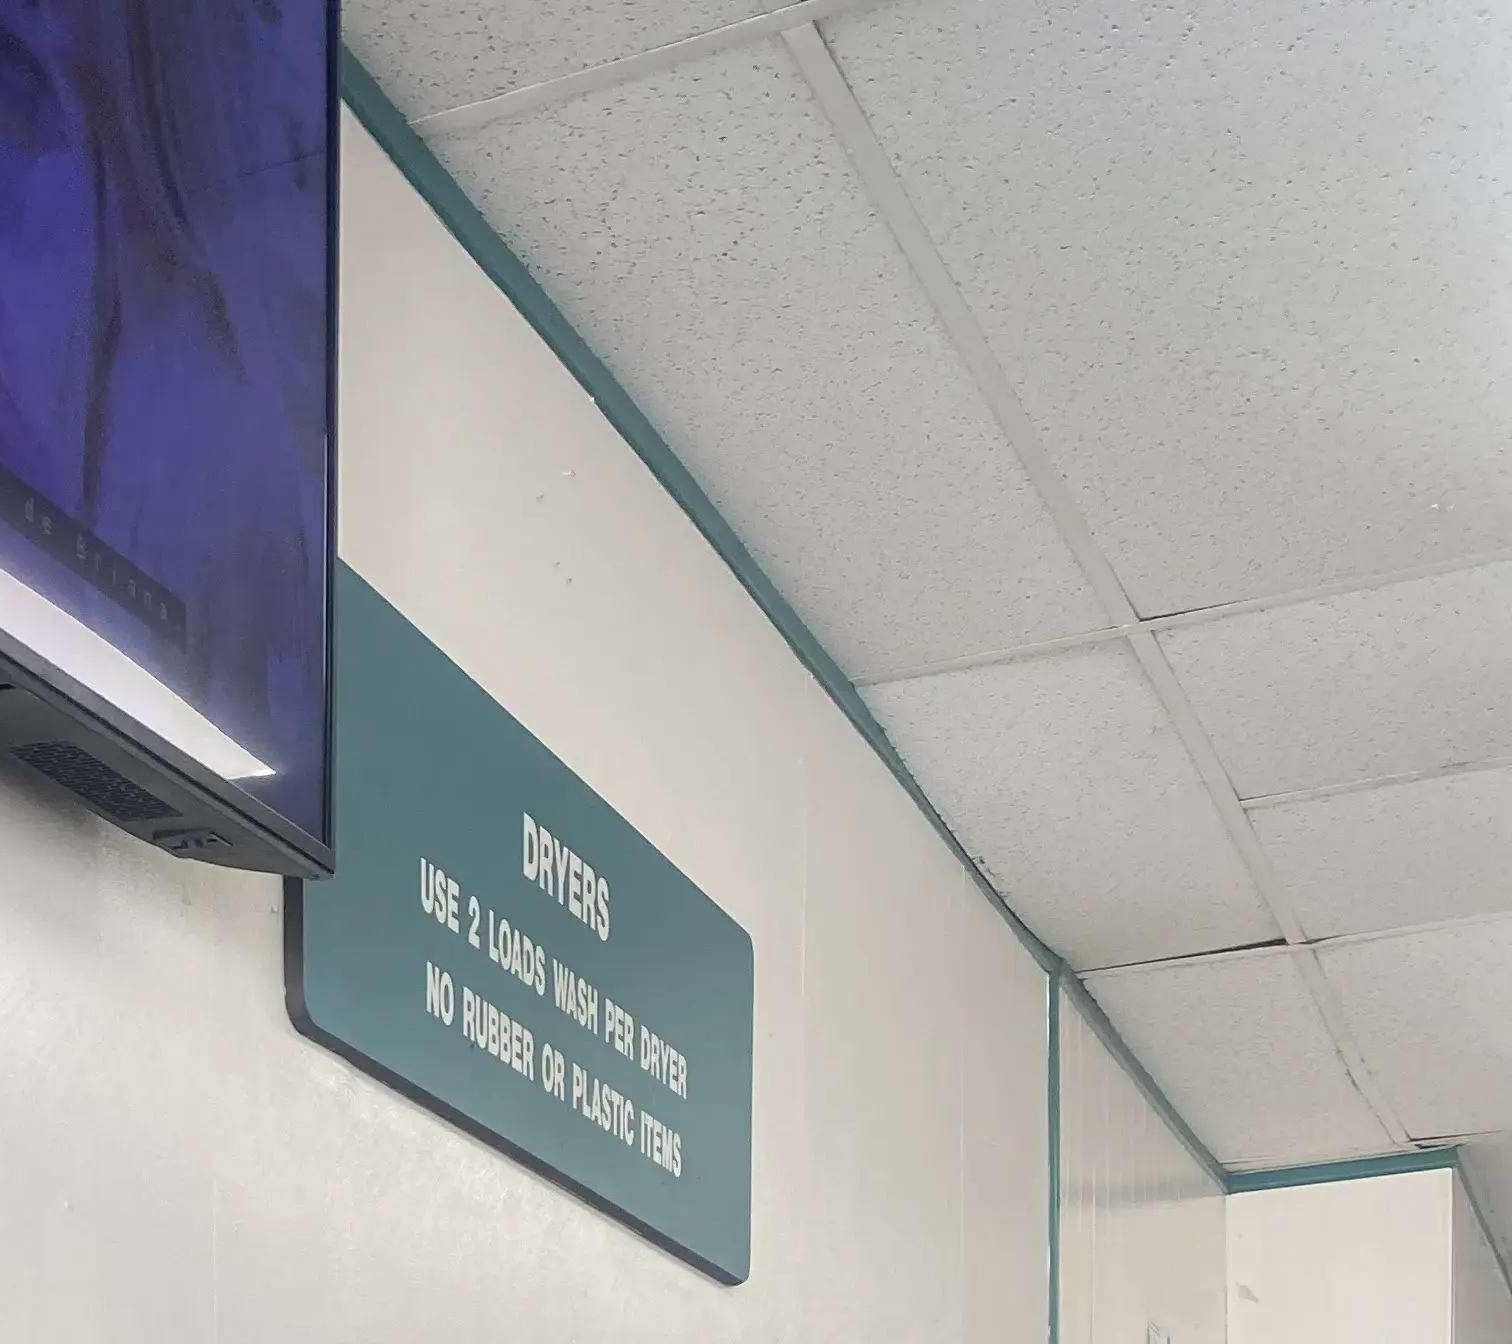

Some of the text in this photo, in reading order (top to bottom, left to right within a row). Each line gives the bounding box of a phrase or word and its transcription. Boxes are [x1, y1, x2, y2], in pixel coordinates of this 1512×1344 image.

[24, 497, 52, 536] de
[523, 811, 610, 941] DRYERS
[420, 857, 687, 1100] USE 2 LOADS WASH PER DRYER
[426, 960, 682, 1178] NO RUBBER OR PLASTIC ITEMS
